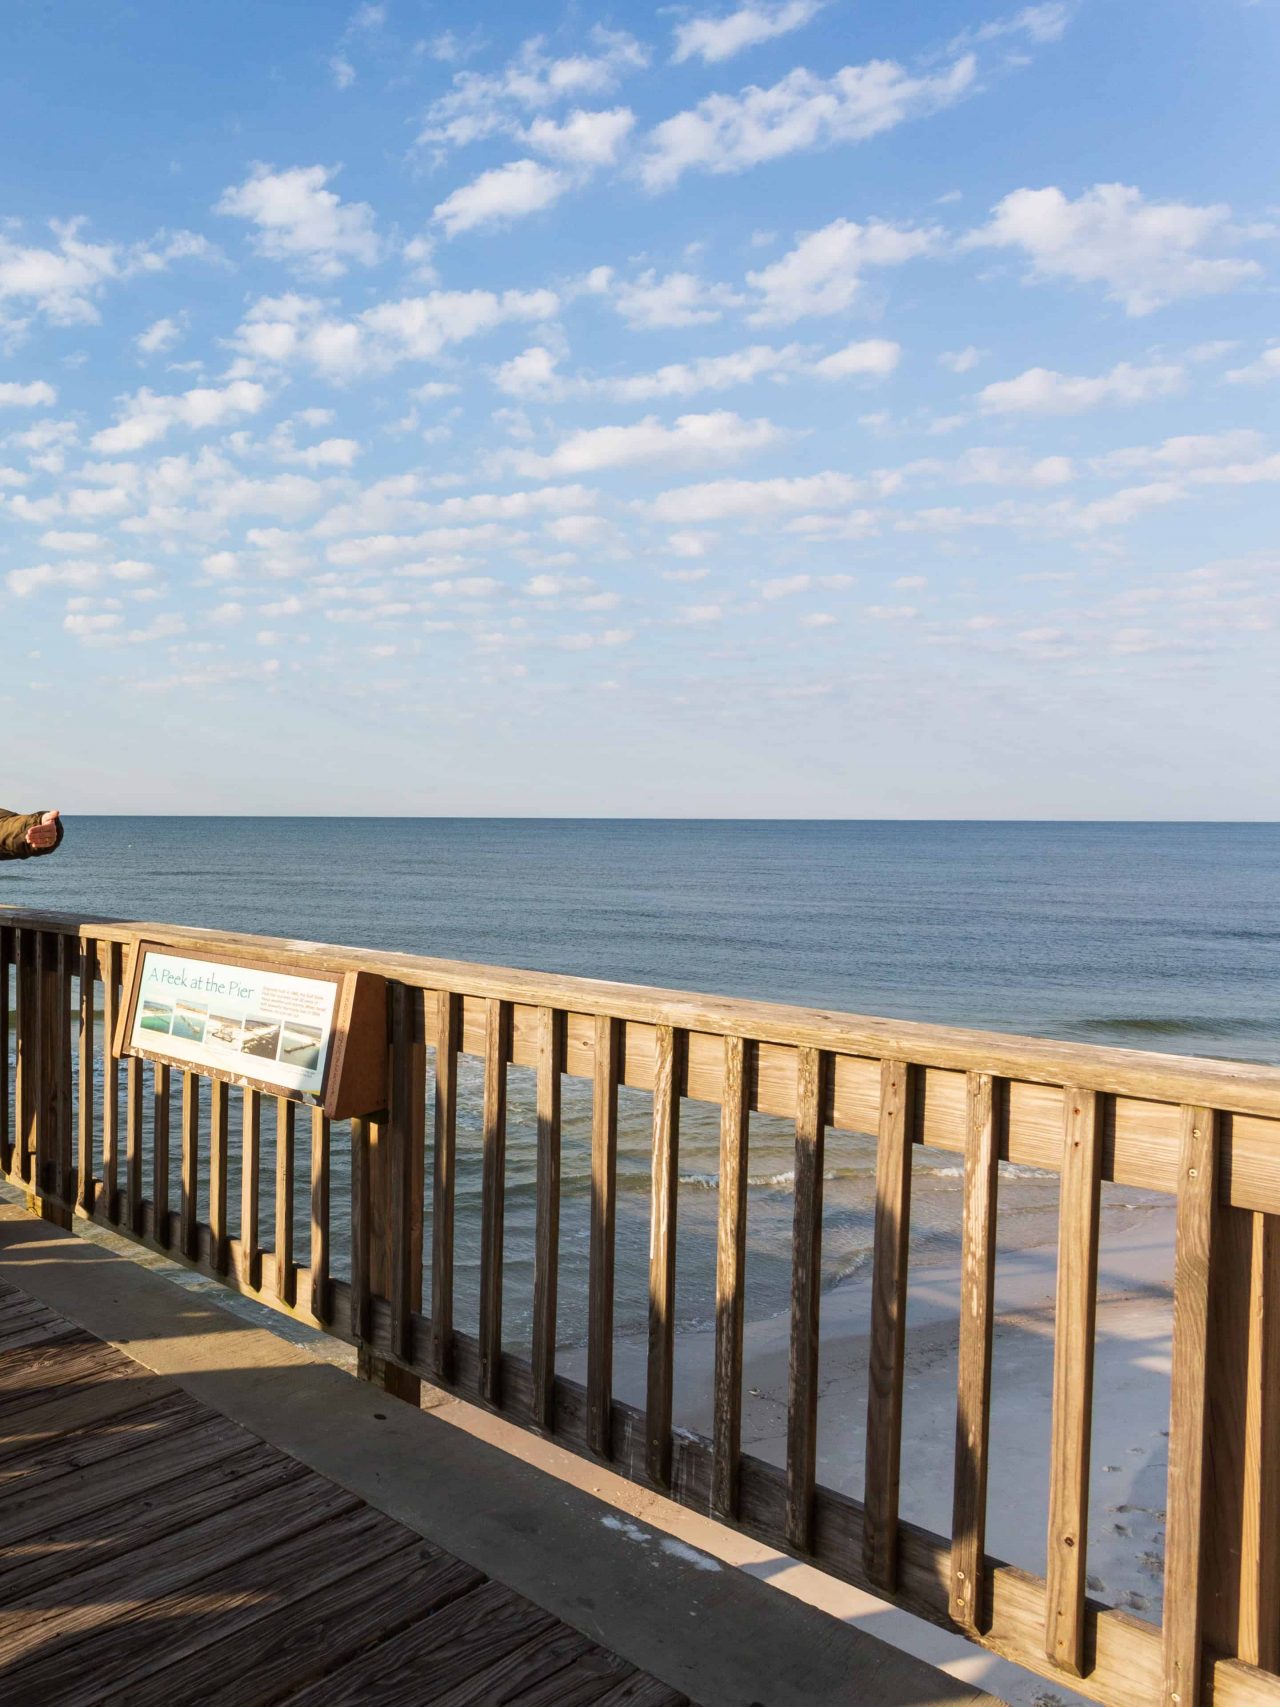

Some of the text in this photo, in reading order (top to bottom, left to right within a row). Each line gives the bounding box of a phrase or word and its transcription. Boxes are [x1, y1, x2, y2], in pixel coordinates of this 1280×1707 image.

[149, 968, 255, 999] A Peek at the Pier
